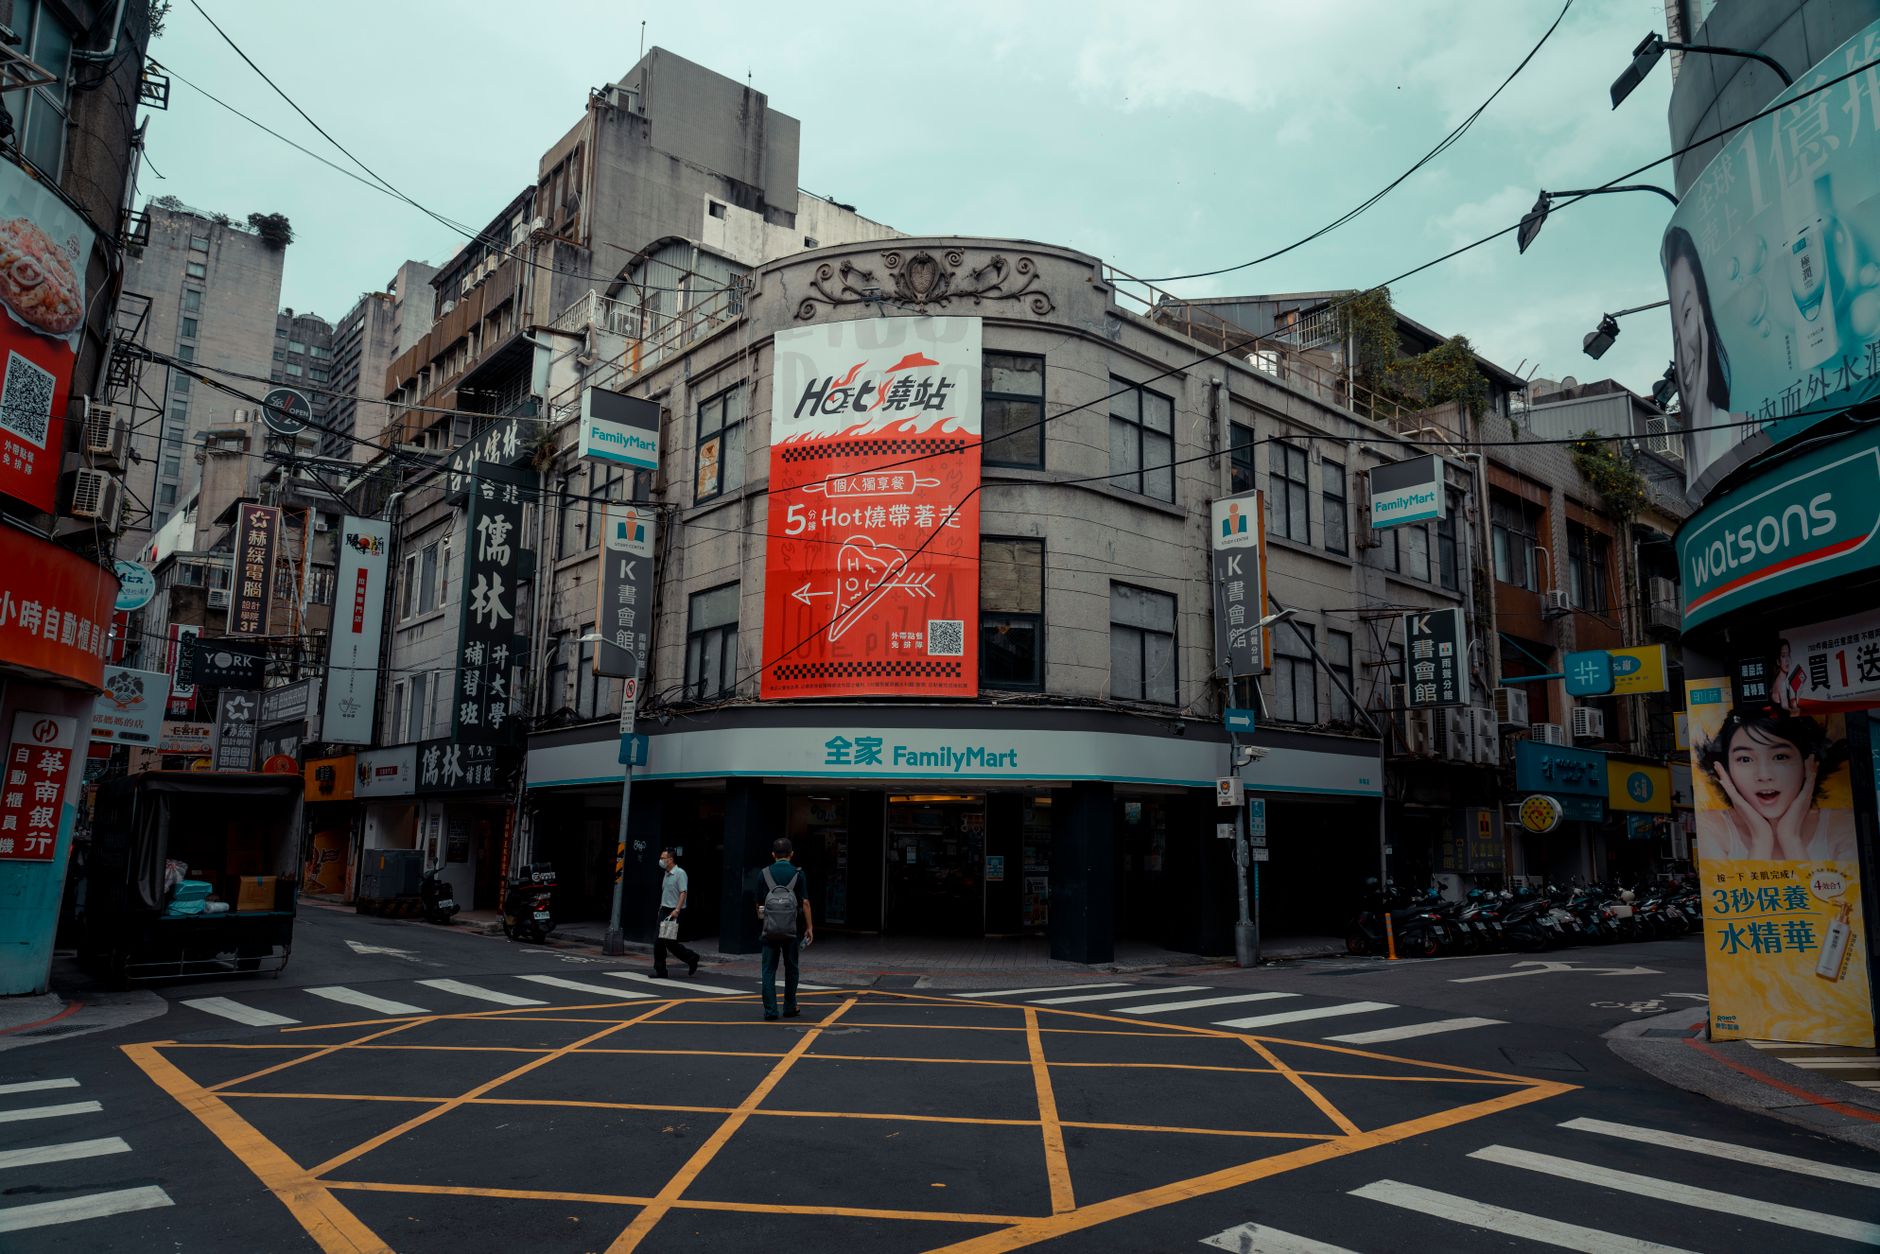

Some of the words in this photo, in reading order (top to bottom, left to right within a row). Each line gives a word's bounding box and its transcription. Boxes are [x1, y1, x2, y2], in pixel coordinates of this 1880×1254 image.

[590, 426, 657, 453] FamilyMart
[481, 479, 519, 504] 台北
[833, 476, 905, 493] 個人獨享餐
[1375, 490, 1435, 513] FamilyMart
[1691, 492, 1837, 588] watsons
[469, 513, 514, 630] 儒林
[615, 559, 638, 651] K書會館
[240, 621, 258, 632] 3F
[204, 652, 253, 668] YORK
[1412, 615, 1437, 702] K書會館
[460, 641, 485, 726] 補習班
[487, 643, 510, 730] 升大學
[421, 743, 464, 788] 儒林
[824, 736, 883, 765] 全家
[893, 745, 1018, 772] FamilyMart
[24, 750, 65, 855] 華南銀行
[1712, 885, 1811, 914] 3秒保養
[1716, 920, 1818, 955] 水精華
